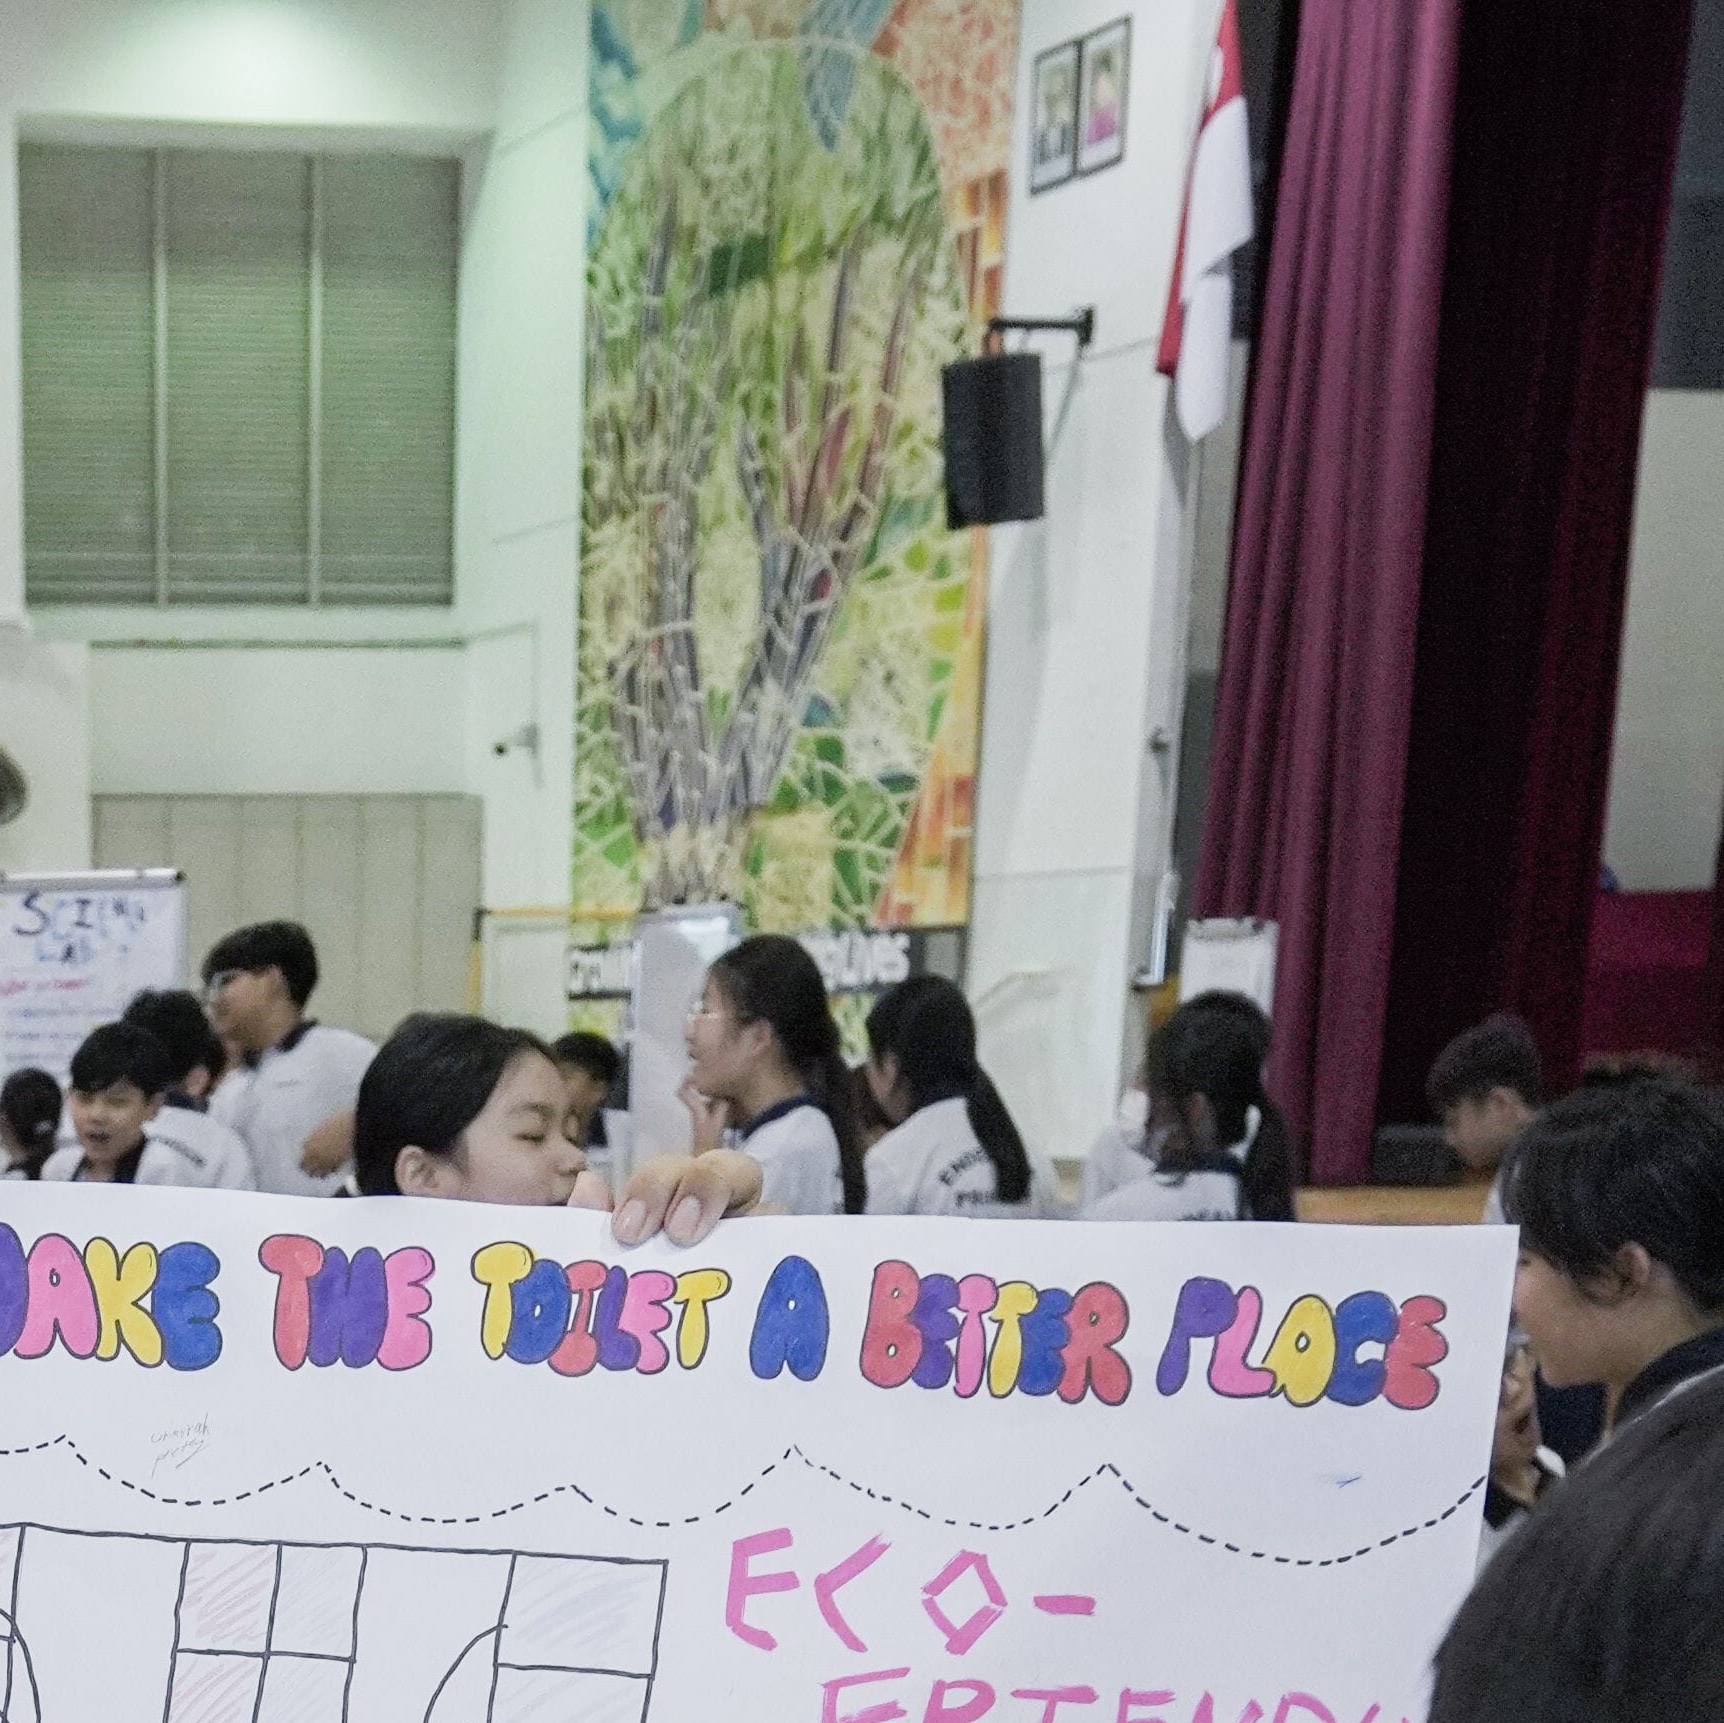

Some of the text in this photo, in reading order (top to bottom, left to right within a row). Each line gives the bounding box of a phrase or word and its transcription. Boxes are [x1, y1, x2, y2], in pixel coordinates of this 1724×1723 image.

[258, 1233, 436, 1372] THE
[470, 1241, 732, 1377] TOILET
[749, 1255, 833, 1382] A
[859, 1259, 1133, 1407] BETTER
[1156, 1276, 1449, 1411] PLACE
